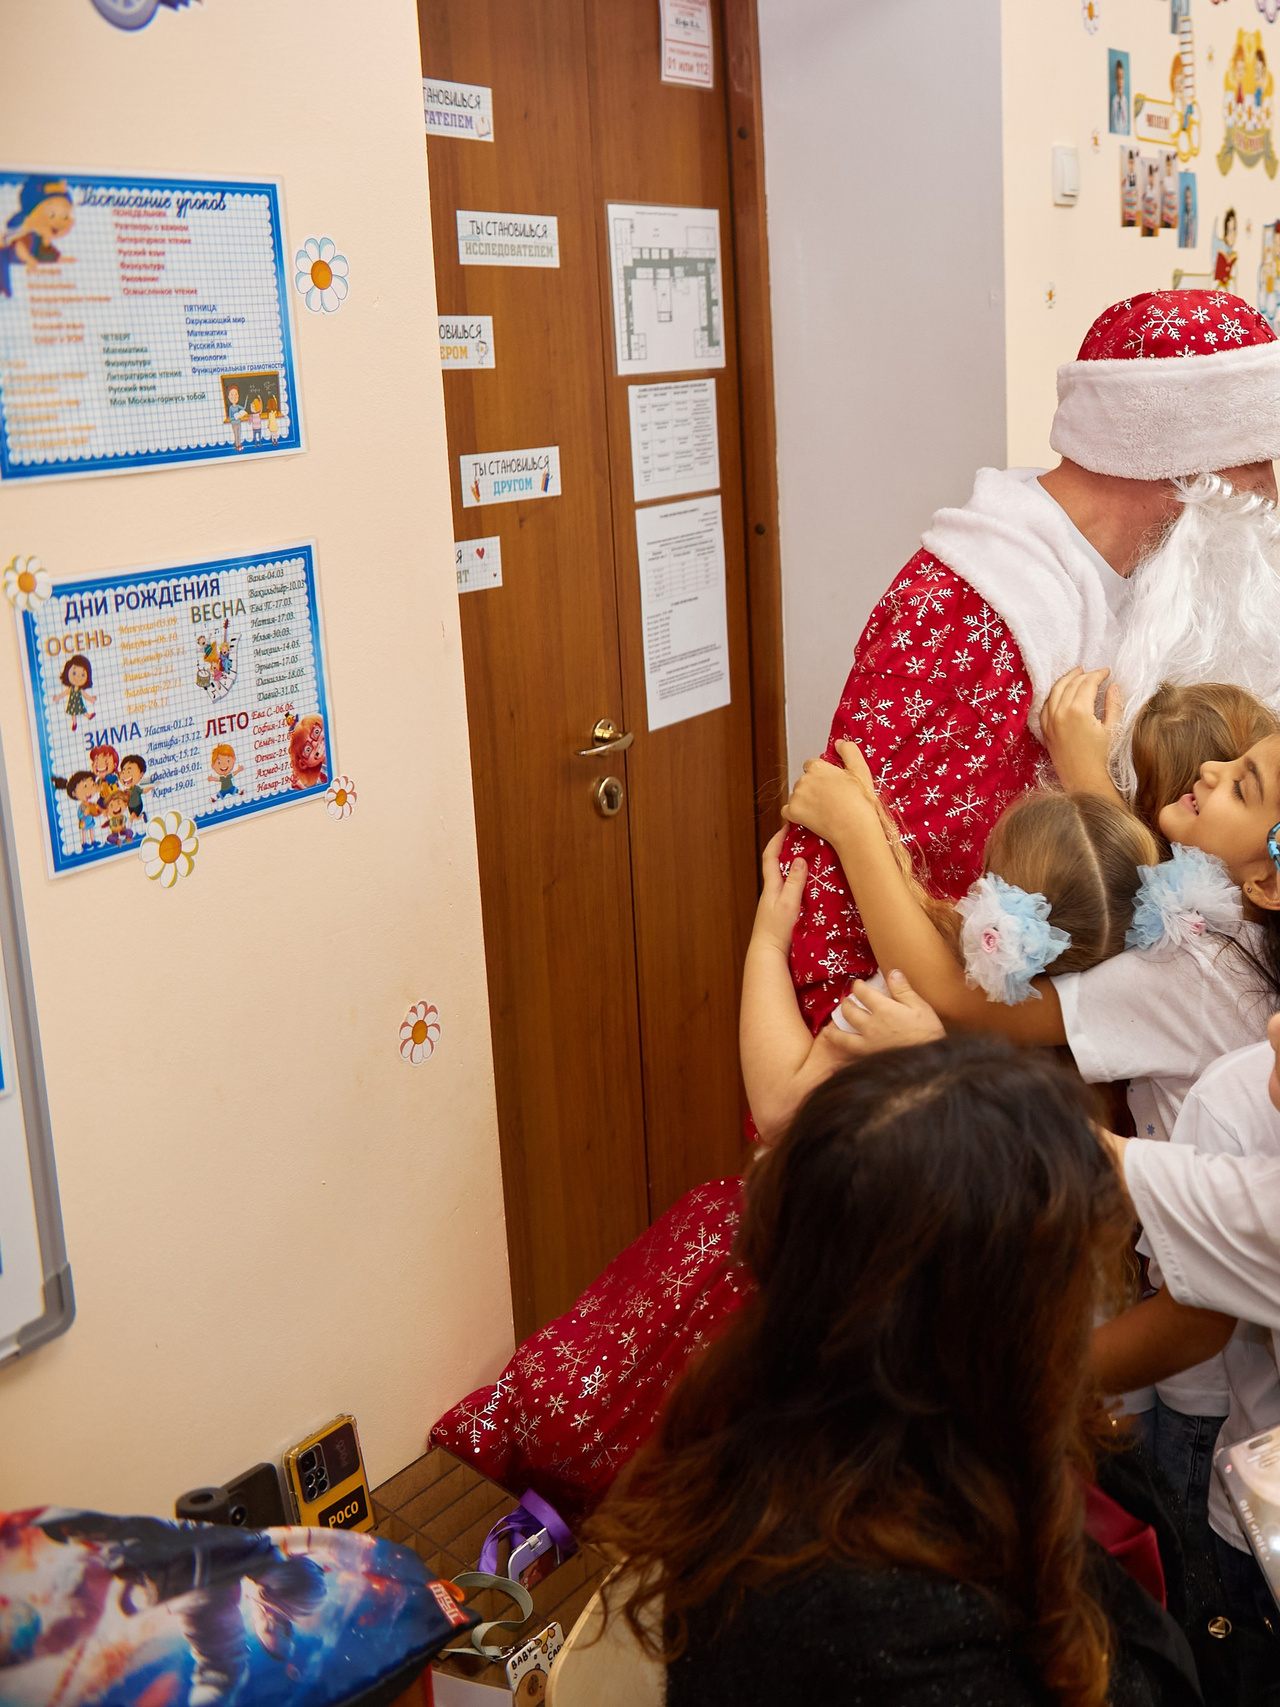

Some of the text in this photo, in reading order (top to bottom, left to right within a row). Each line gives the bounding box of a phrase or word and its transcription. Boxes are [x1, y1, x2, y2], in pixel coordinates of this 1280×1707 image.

[423, 86, 481, 109] ТАНОВИШЬСЯ
[424, 109, 474, 130] ТАТЕЛЕМ
[78, 185, 227, 218] Расписание уроков
[112, 209, 167, 218] ПОНЕДЕЛЬНИК
[469, 220, 548, 239] ТЫ СТАНОВИШЬСЯ
[118, 248, 146, 258] Русский
[465, 242, 554, 258] ИССЛЕДОВАТЕЛЕМ
[120, 262, 165, 270] Физкультура
[184, 304, 218, 313] ПЯТНИЦА
[186, 316, 246, 326] Окружающий мир
[100, 333, 131, 342] ЧЕТВЕРГ
[439, 324, 482, 340] ОВИШЬСЯ
[102, 346, 148, 354] Математика
[188, 340, 215, 350] Русский
[440, 346, 468, 360] ЕРОМ
[104, 359, 152, 368] Физкультура
[190, 354, 227, 362] Технология
[106, 370, 182, 381] Литературное чтение
[192, 362, 284, 375] Функциональная грамотность
[108, 384, 138, 394] Русский
[110, 398, 126, 406] Моя
[186, 392, 206, 401] тобой
[472, 455, 550, 477] ТЫ СТАНОВИШЬСЯ
[493, 477, 534, 496] ДРУГОМ
[64, 578, 221, 625] ДНИ РОЖДЕНИЯ
[249, 602, 264, 614] Ева
[190, 598, 247, 624] ВЕСНА
[45, 628, 112, 656] ОСЕНЬ
[254, 640, 301, 658] Михаил-14.05.
[251, 710, 266, 720] Ева
[144, 716, 195, 737] Настя-01.12.
[205, 712, 249, 739] ЛЕТО
[252, 719, 288, 736] София-14.
[84, 722, 142, 751] ЗИМА
[146, 730, 202, 754] Латифа-13.12.
[254, 731, 294, 750] Семён-21.0
[148, 746, 200, 767] Владик-15.12.
[254, 748, 289, 764] Денис-25.
[150, 762, 202, 784] Фаддей-05.01.
[256, 762, 294, 780] Ахмед-17.0
[152, 779, 196, 798] Кира-19.01.
[256, 774, 298, 793] Назар-19.0
[328, 1500, 359, 1529] POCO
[511, 1646, 533, 1671] BABY
